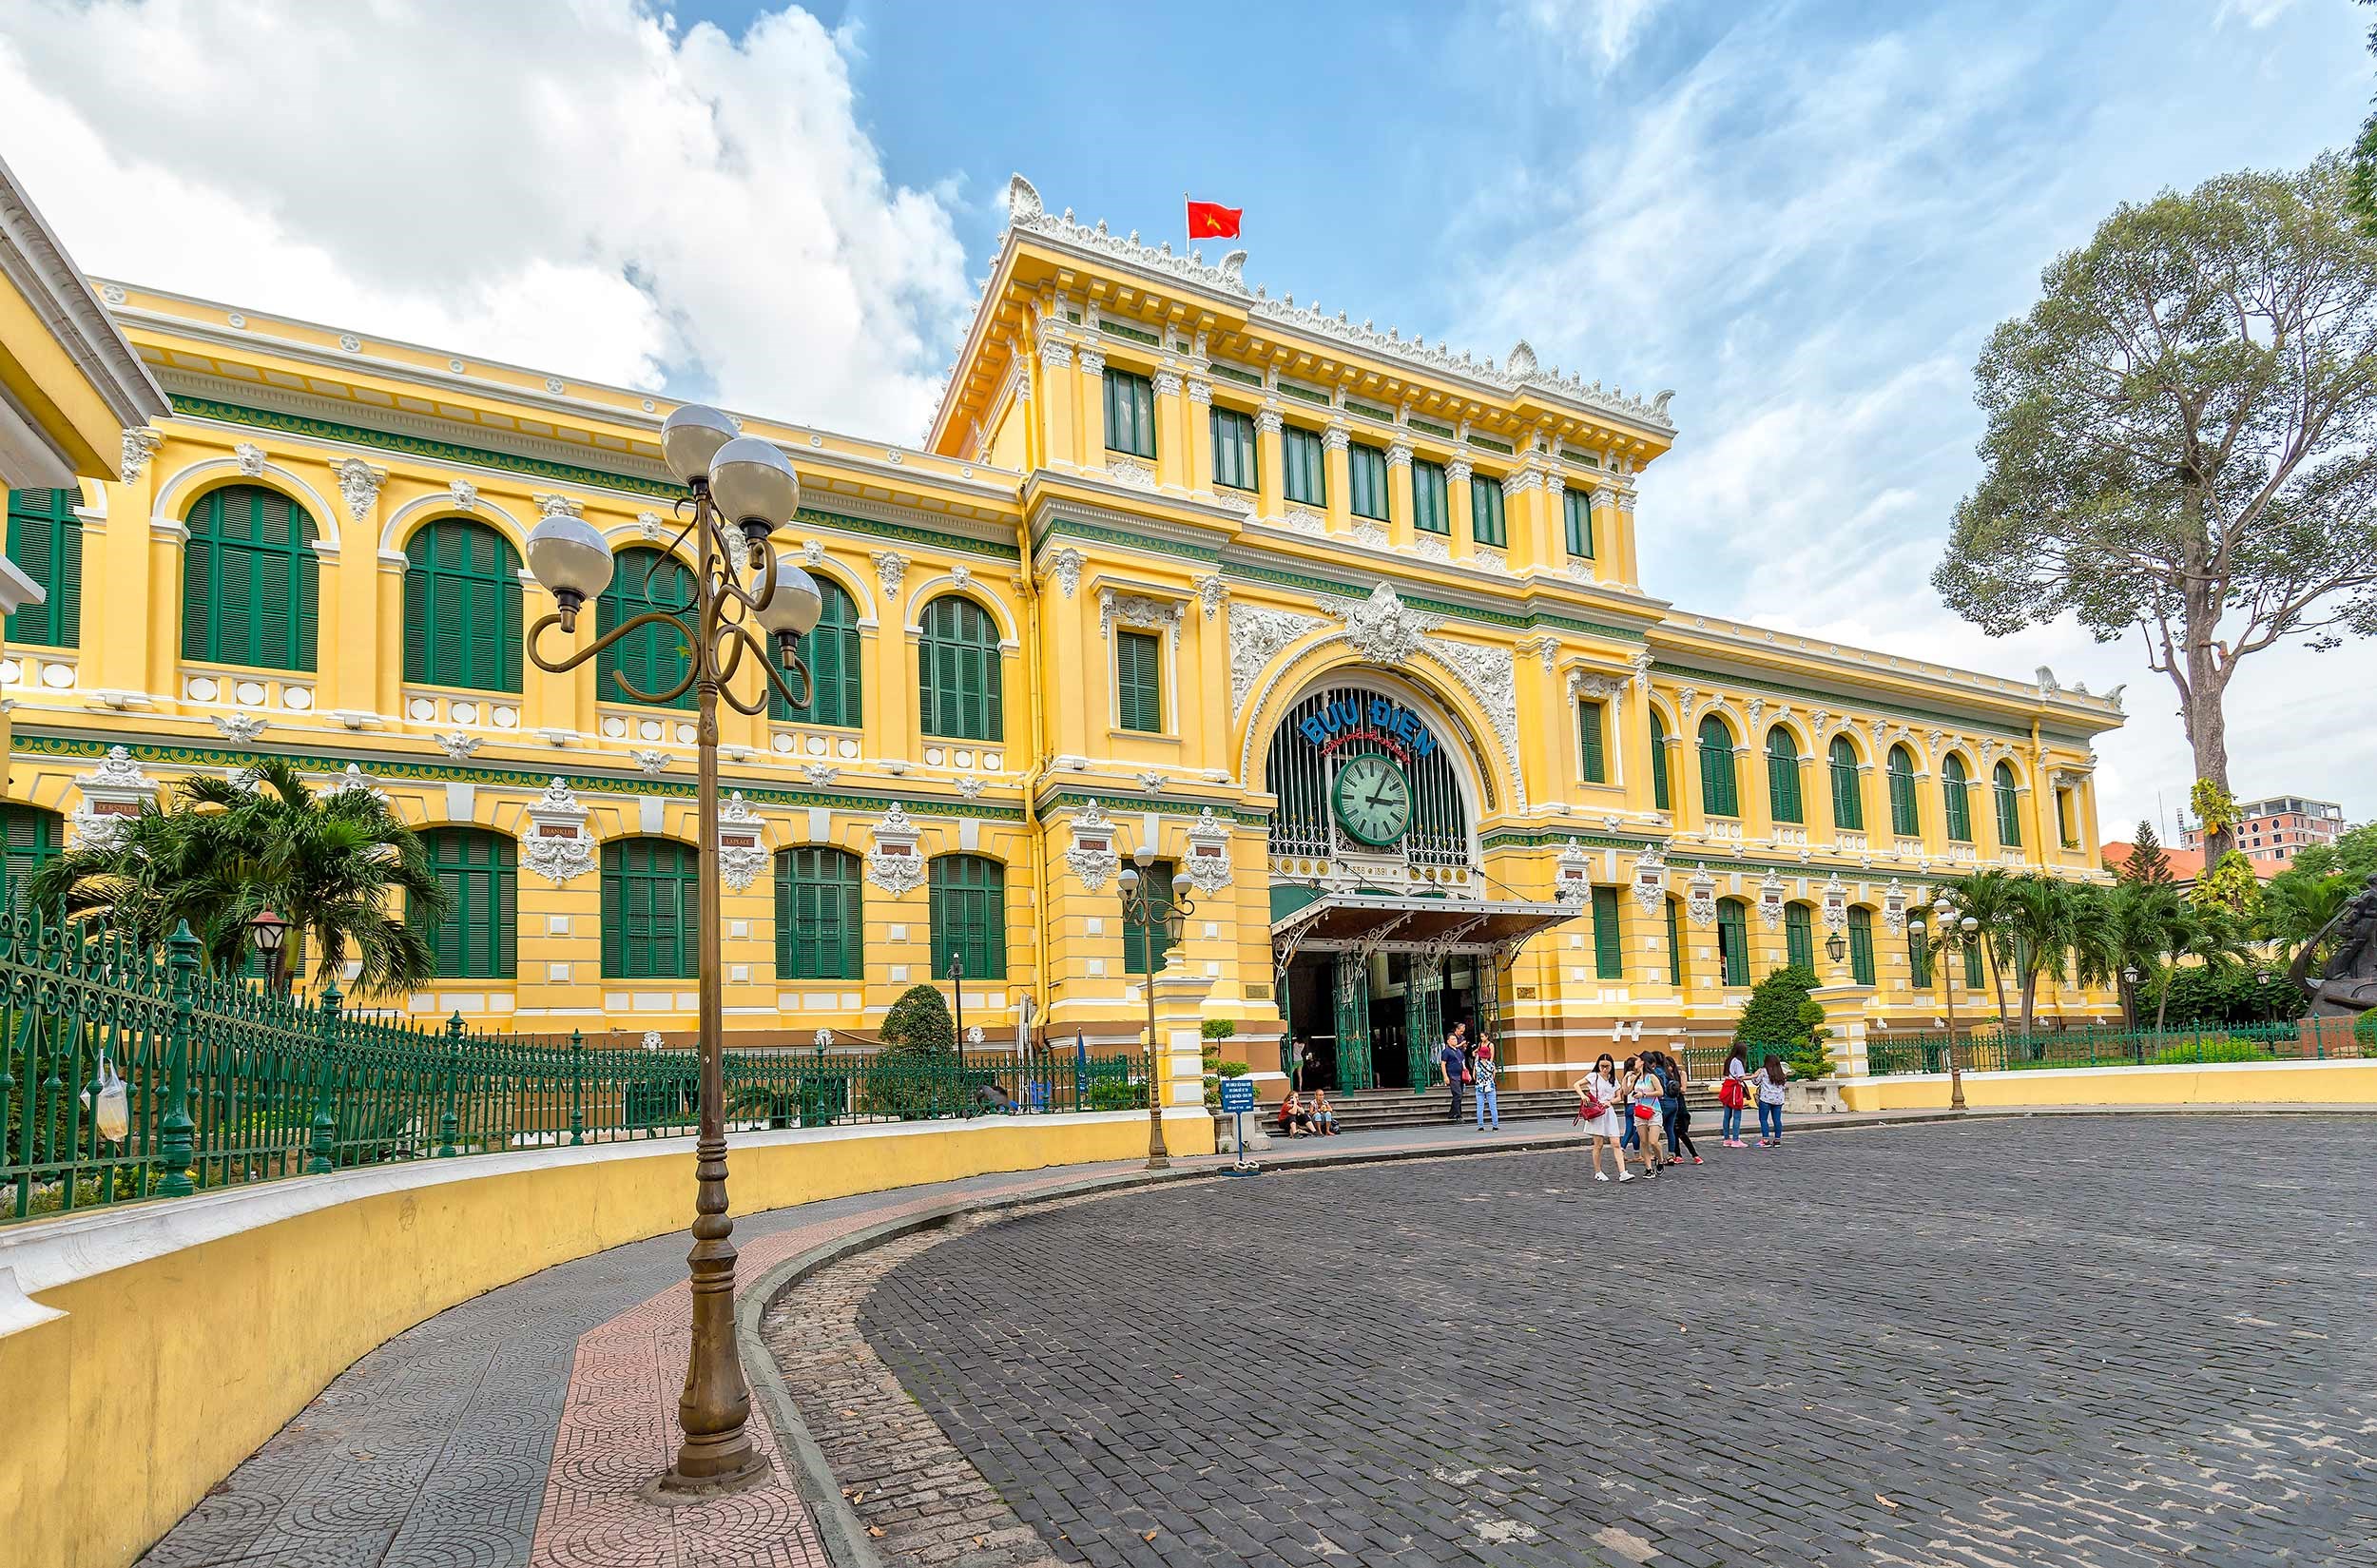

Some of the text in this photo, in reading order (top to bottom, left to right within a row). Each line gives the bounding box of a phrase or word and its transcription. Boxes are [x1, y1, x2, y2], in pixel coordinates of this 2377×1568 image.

[1300, 698, 1438, 758] BƯU ĐIỆN
[542, 827, 576, 836] FRANKLIN
